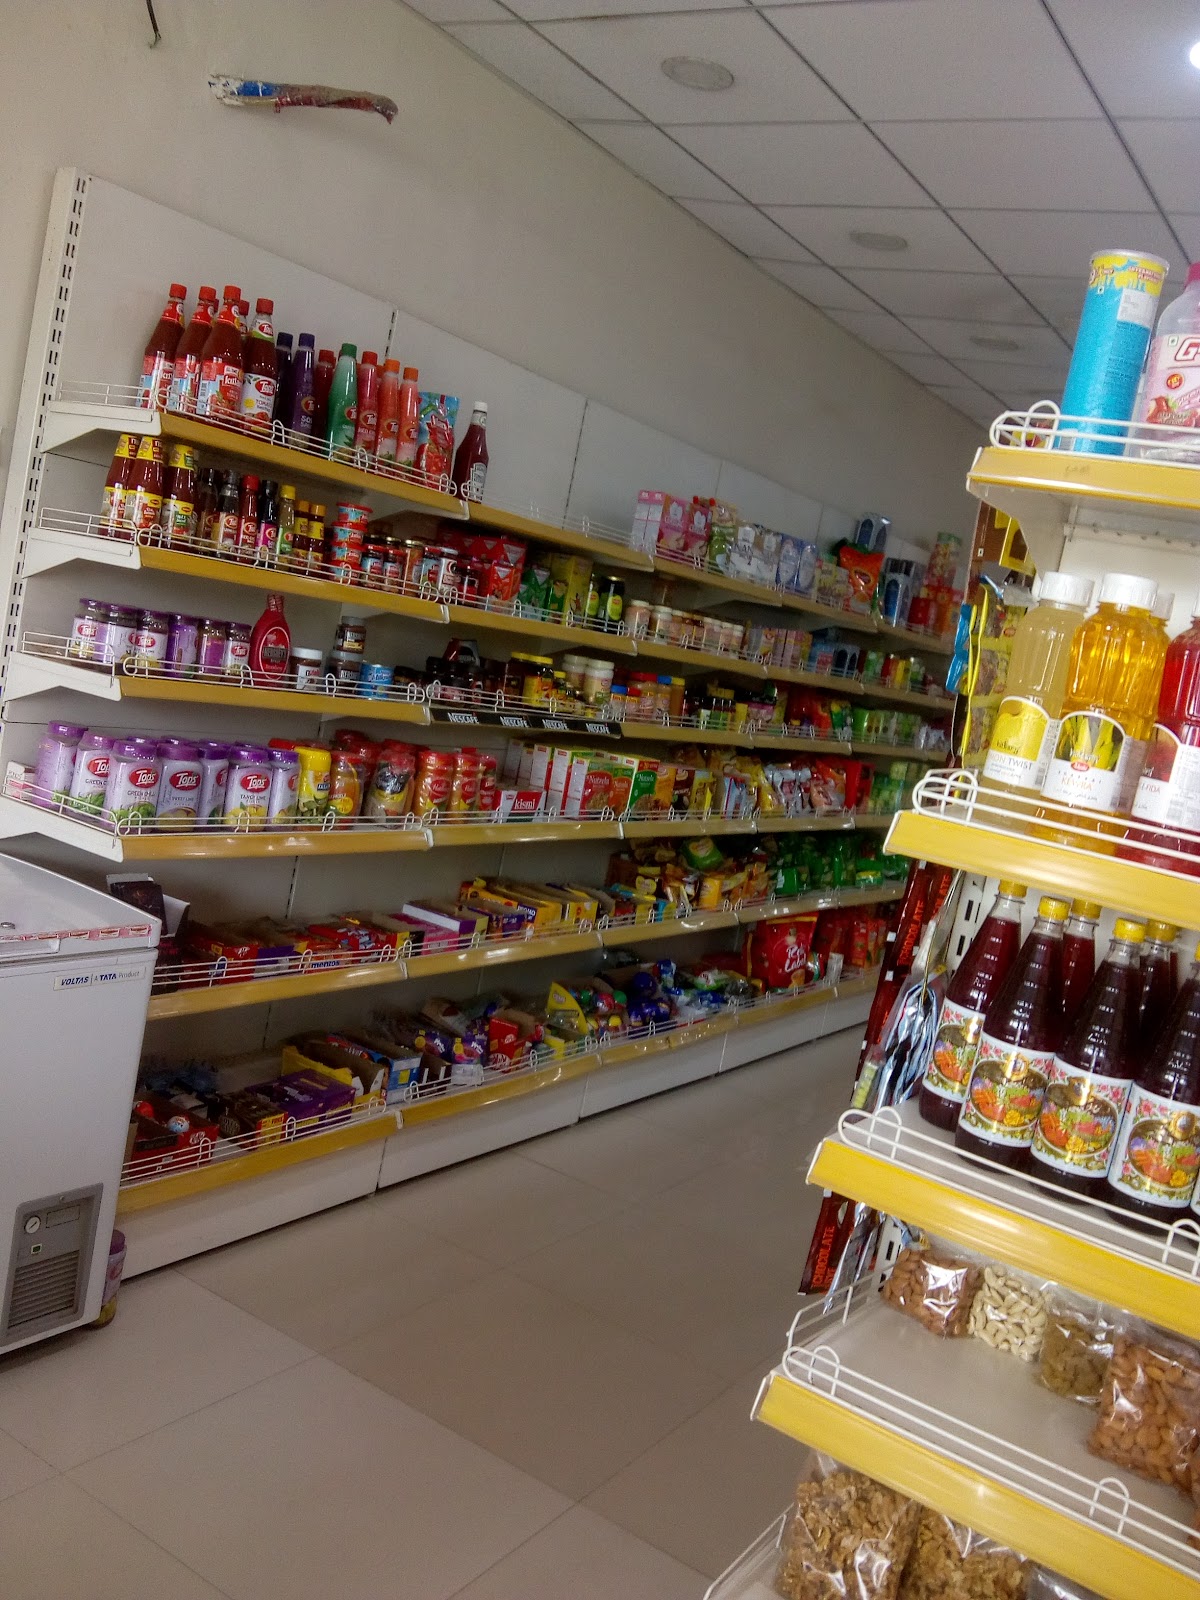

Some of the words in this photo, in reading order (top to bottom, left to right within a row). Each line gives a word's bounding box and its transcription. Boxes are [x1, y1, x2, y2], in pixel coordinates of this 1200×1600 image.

[1008, 757, 1033, 771] TWIST
[135, 769, 157, 786] Tops
[175, 772, 199, 788] Tops
[246, 774, 267, 790] Tops
[60, 976, 89, 986] VOLTAS
[99, 973, 117, 982] TATA
[118, 970, 140, 979] Product
